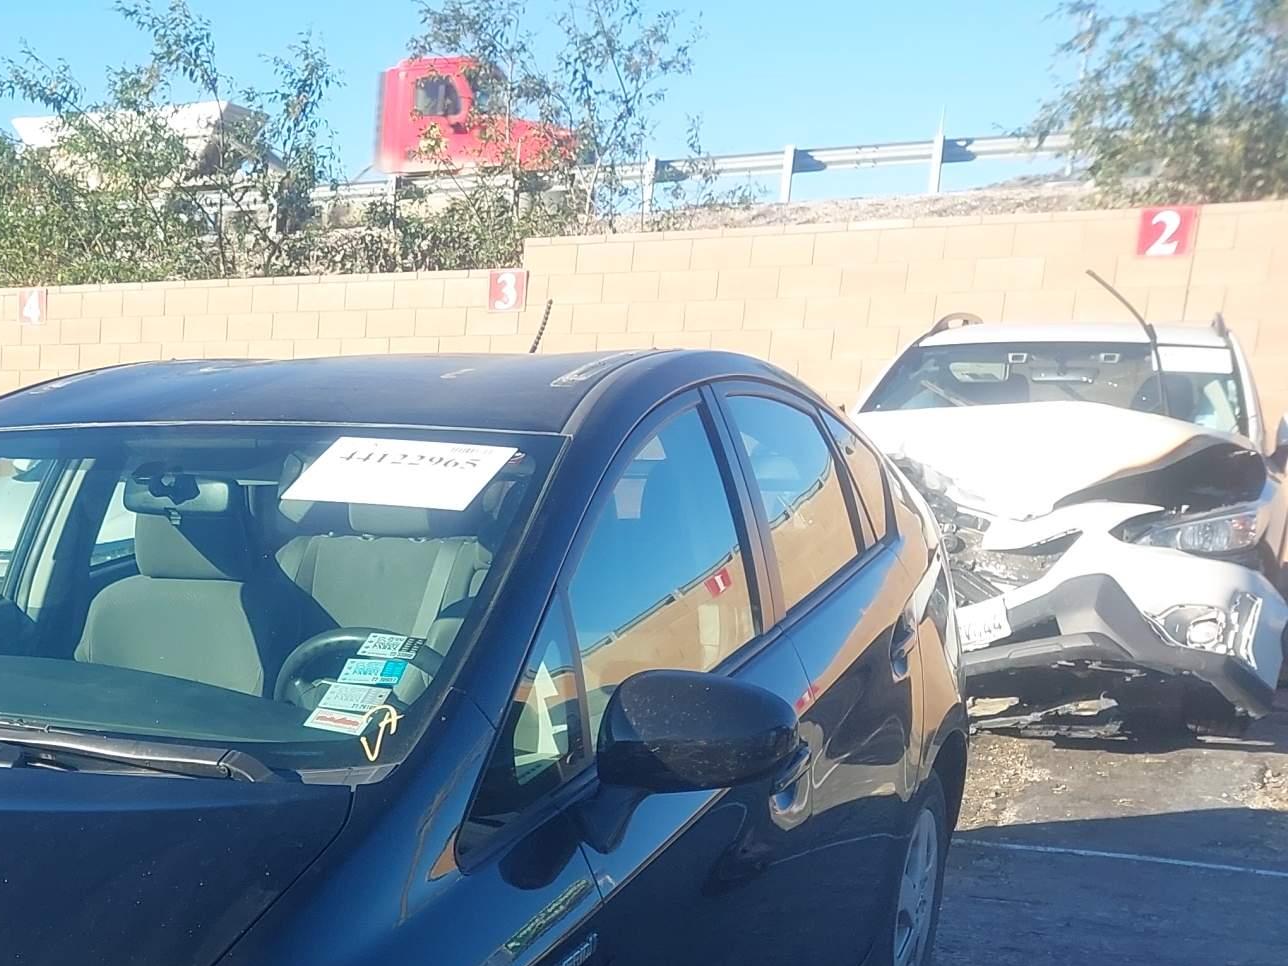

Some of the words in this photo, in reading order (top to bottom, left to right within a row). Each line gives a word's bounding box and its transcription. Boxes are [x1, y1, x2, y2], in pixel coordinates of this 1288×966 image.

[1144, 208, 1182, 257] 2
[22, 289, 42, 325] 4
[494, 271, 518, 311] 3
[340, 450, 481, 470] 44122965
